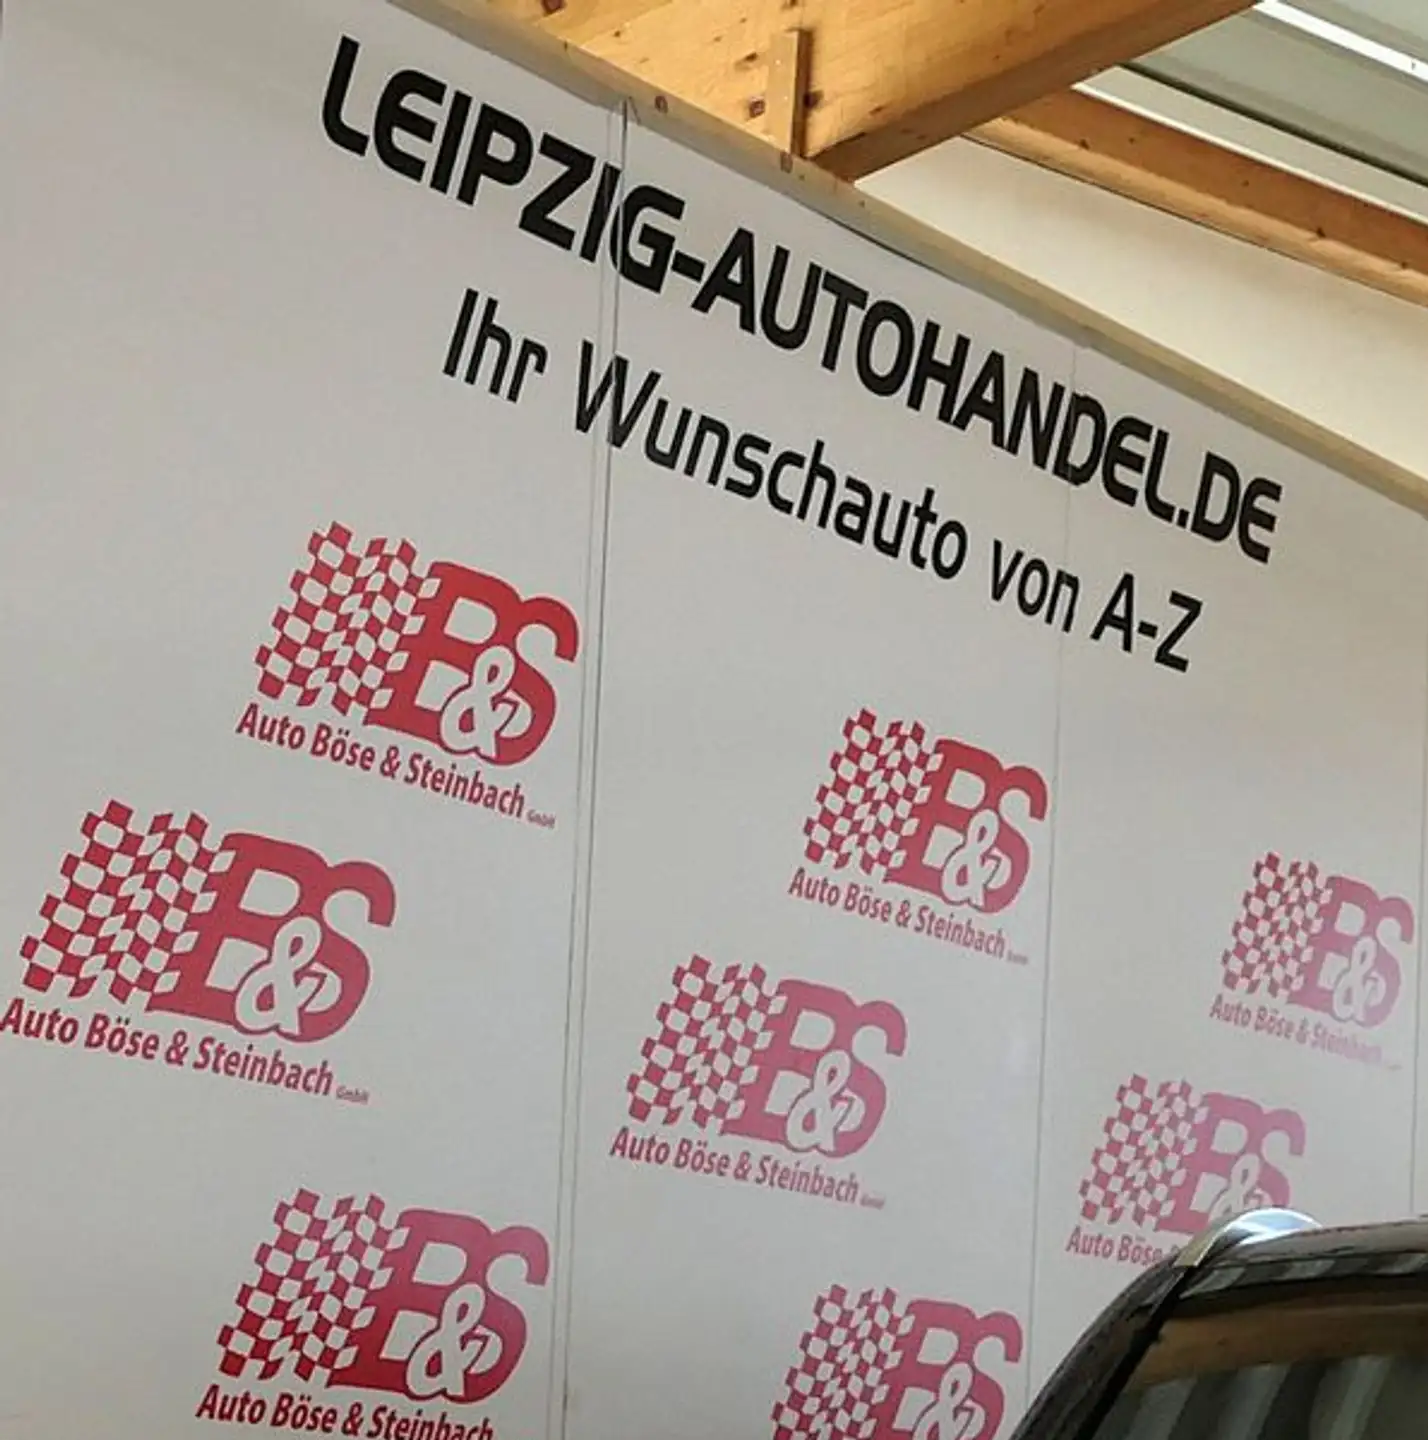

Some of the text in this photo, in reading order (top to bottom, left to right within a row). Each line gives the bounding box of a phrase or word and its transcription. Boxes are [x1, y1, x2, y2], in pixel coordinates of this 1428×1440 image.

[322, 36, 1283, 564] LEIPZIG-AUTOHANDEL.DE
[442, 288, 1203, 673] Ihr Wunschauto von A-Z
[235, 702, 307, 749] Auto
[310, 722, 377, 771] Böse
[380, 746, 401, 779] &
[404, 752, 525, 818] Steinbach
[787, 867, 841, 906] Auto
[843, 881, 894, 924] Böse
[895, 900, 913, 929] &
[914, 905, 1006, 958] Steinbach
[0, 998, 80, 1044] Auto
[84, 1012, 161, 1061] Böse
[164, 1029, 190, 1066] &
[192, 1036, 335, 1097] Steinbach
[1209, 993, 1252, 1028] Auto
[1254, 1006, 1296, 1039] Böse
[610, 1126, 670, 1166] Auto
[673, 1138, 731, 1177] Böse
[733, 1151, 752, 1181] &
[754, 1154, 860, 1204] Steinbach
[1065, 1226, 1115, 1259] Auto
[195, 1384, 267, 1425] Auto
[270, 1392, 338, 1433] Böse
[340, 1401, 364, 1438] &
